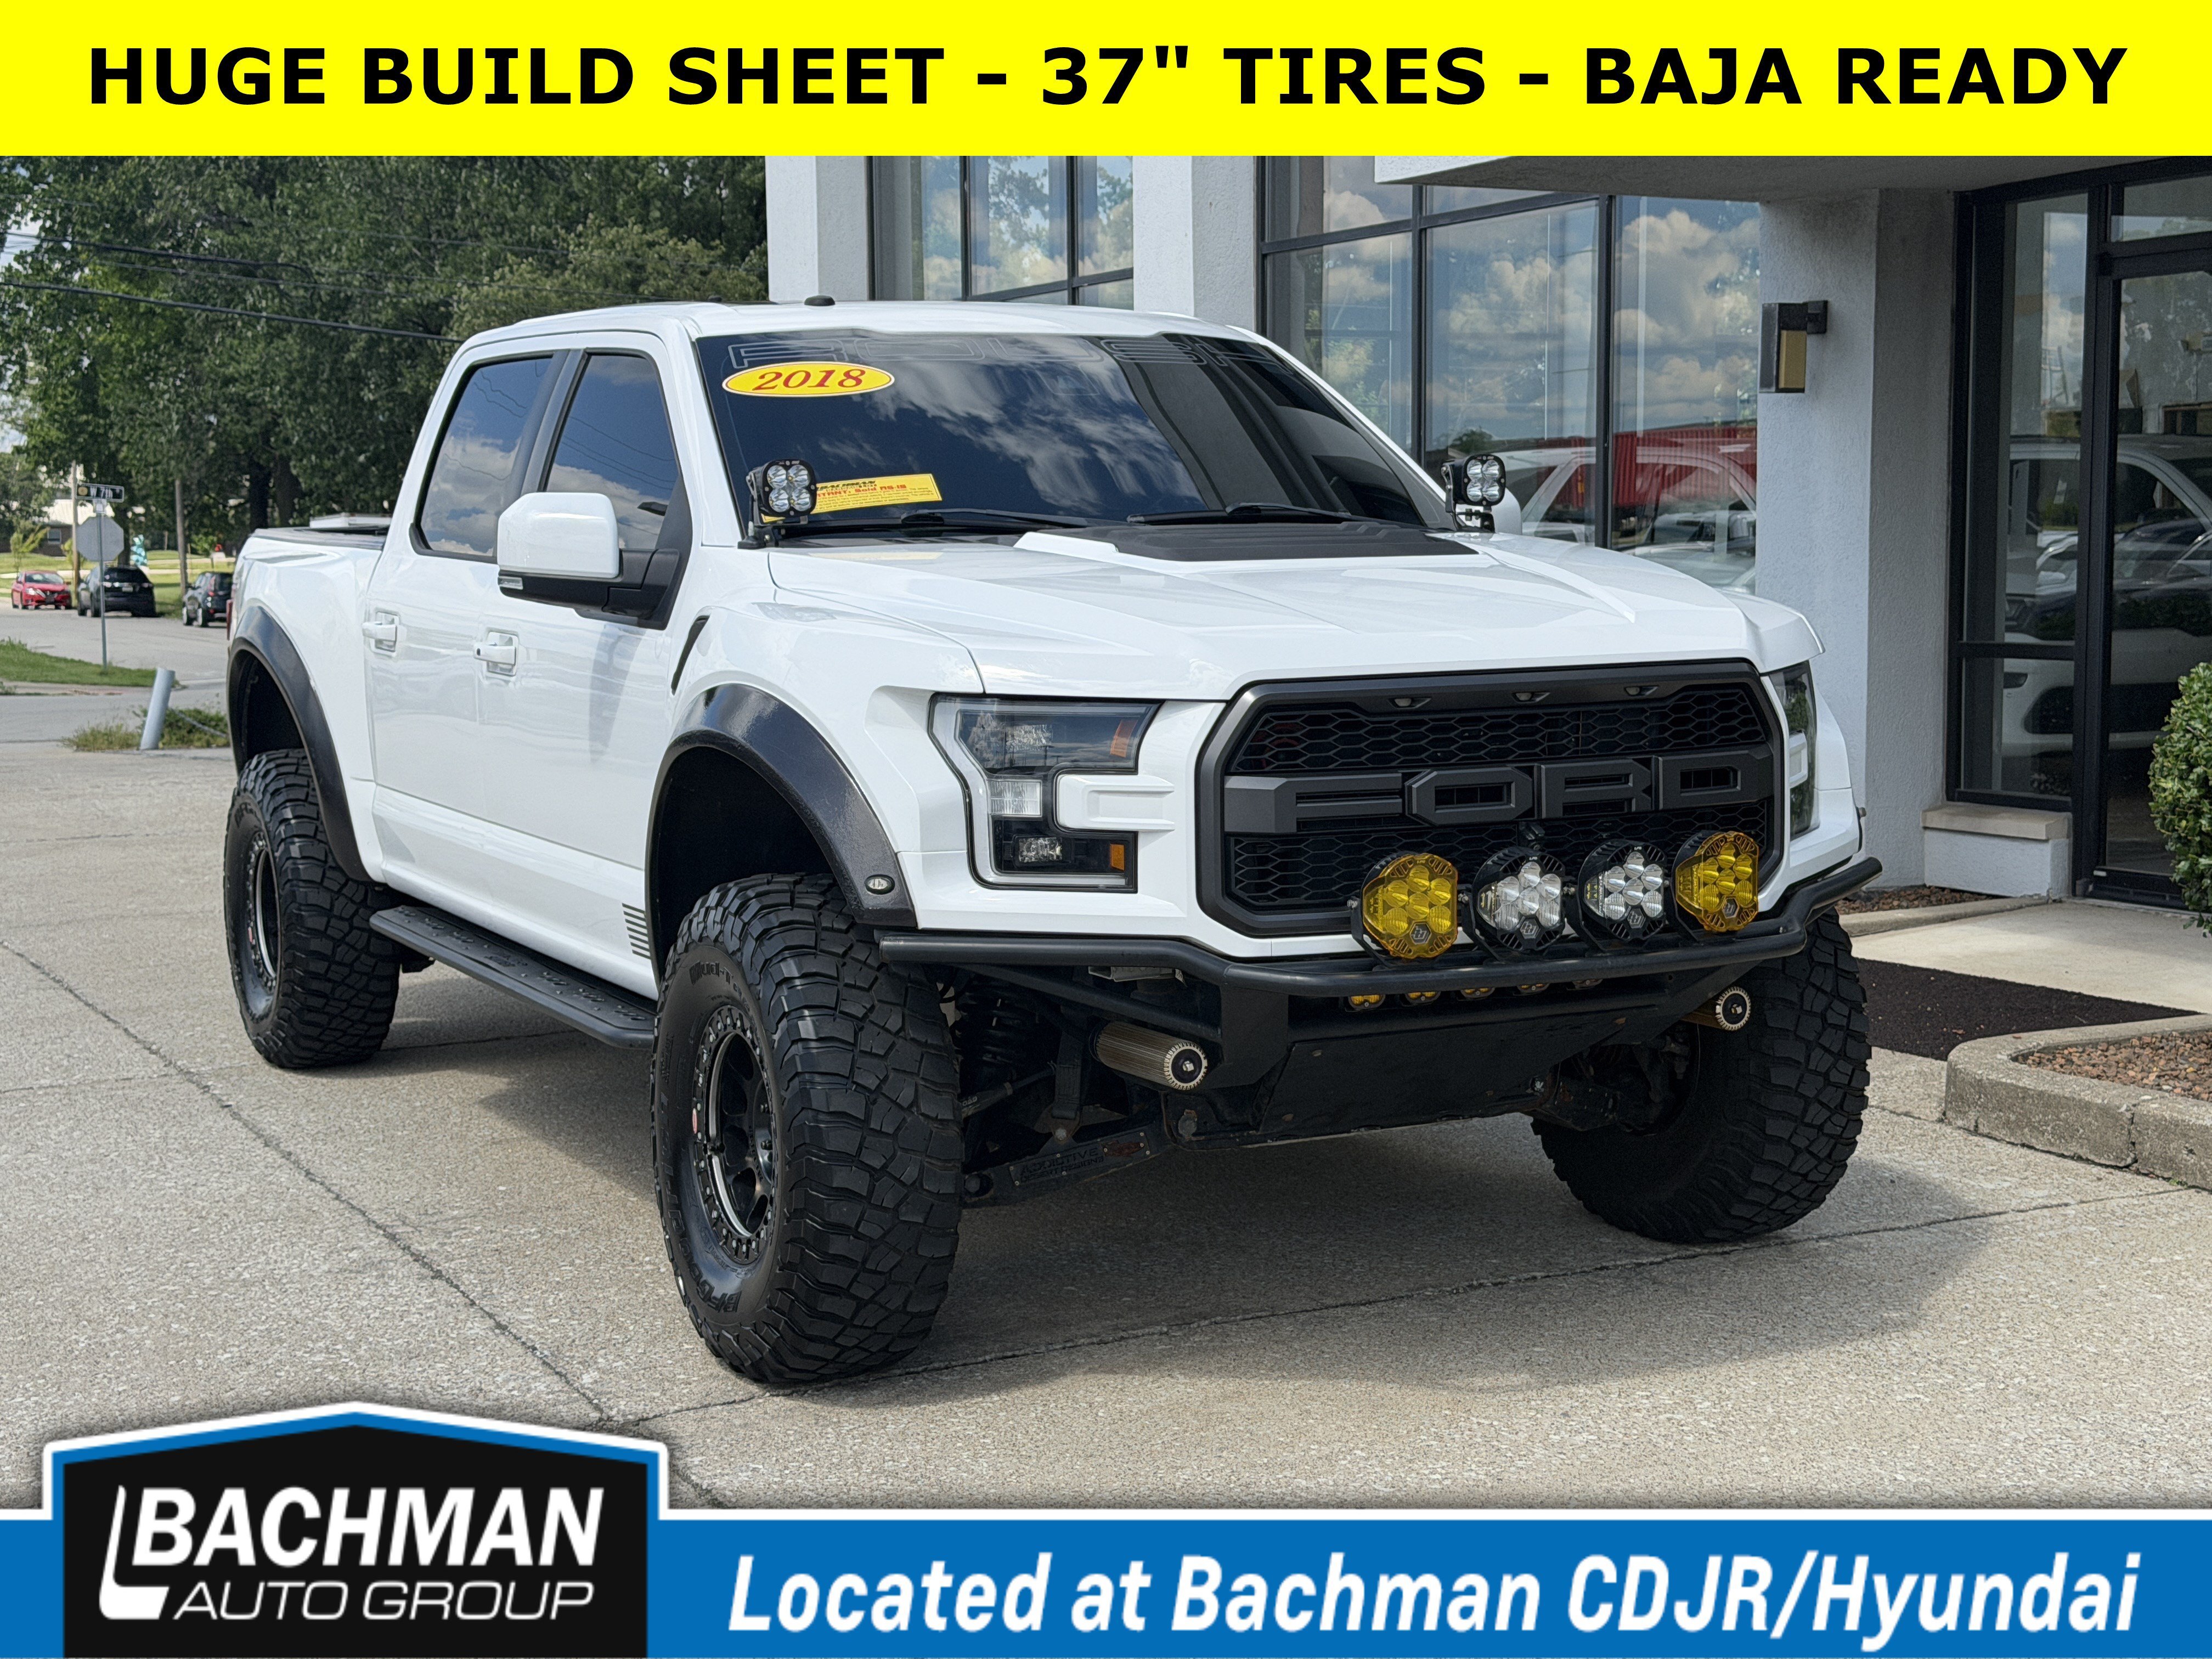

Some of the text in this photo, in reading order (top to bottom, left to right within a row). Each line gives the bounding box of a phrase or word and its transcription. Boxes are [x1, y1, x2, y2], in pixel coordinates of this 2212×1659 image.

[752, 368, 866, 391] 2018
[90, 485, 97, 497] W
[100, 486, 113, 498] 7th
[1224, 748, 1773, 833] FORD
